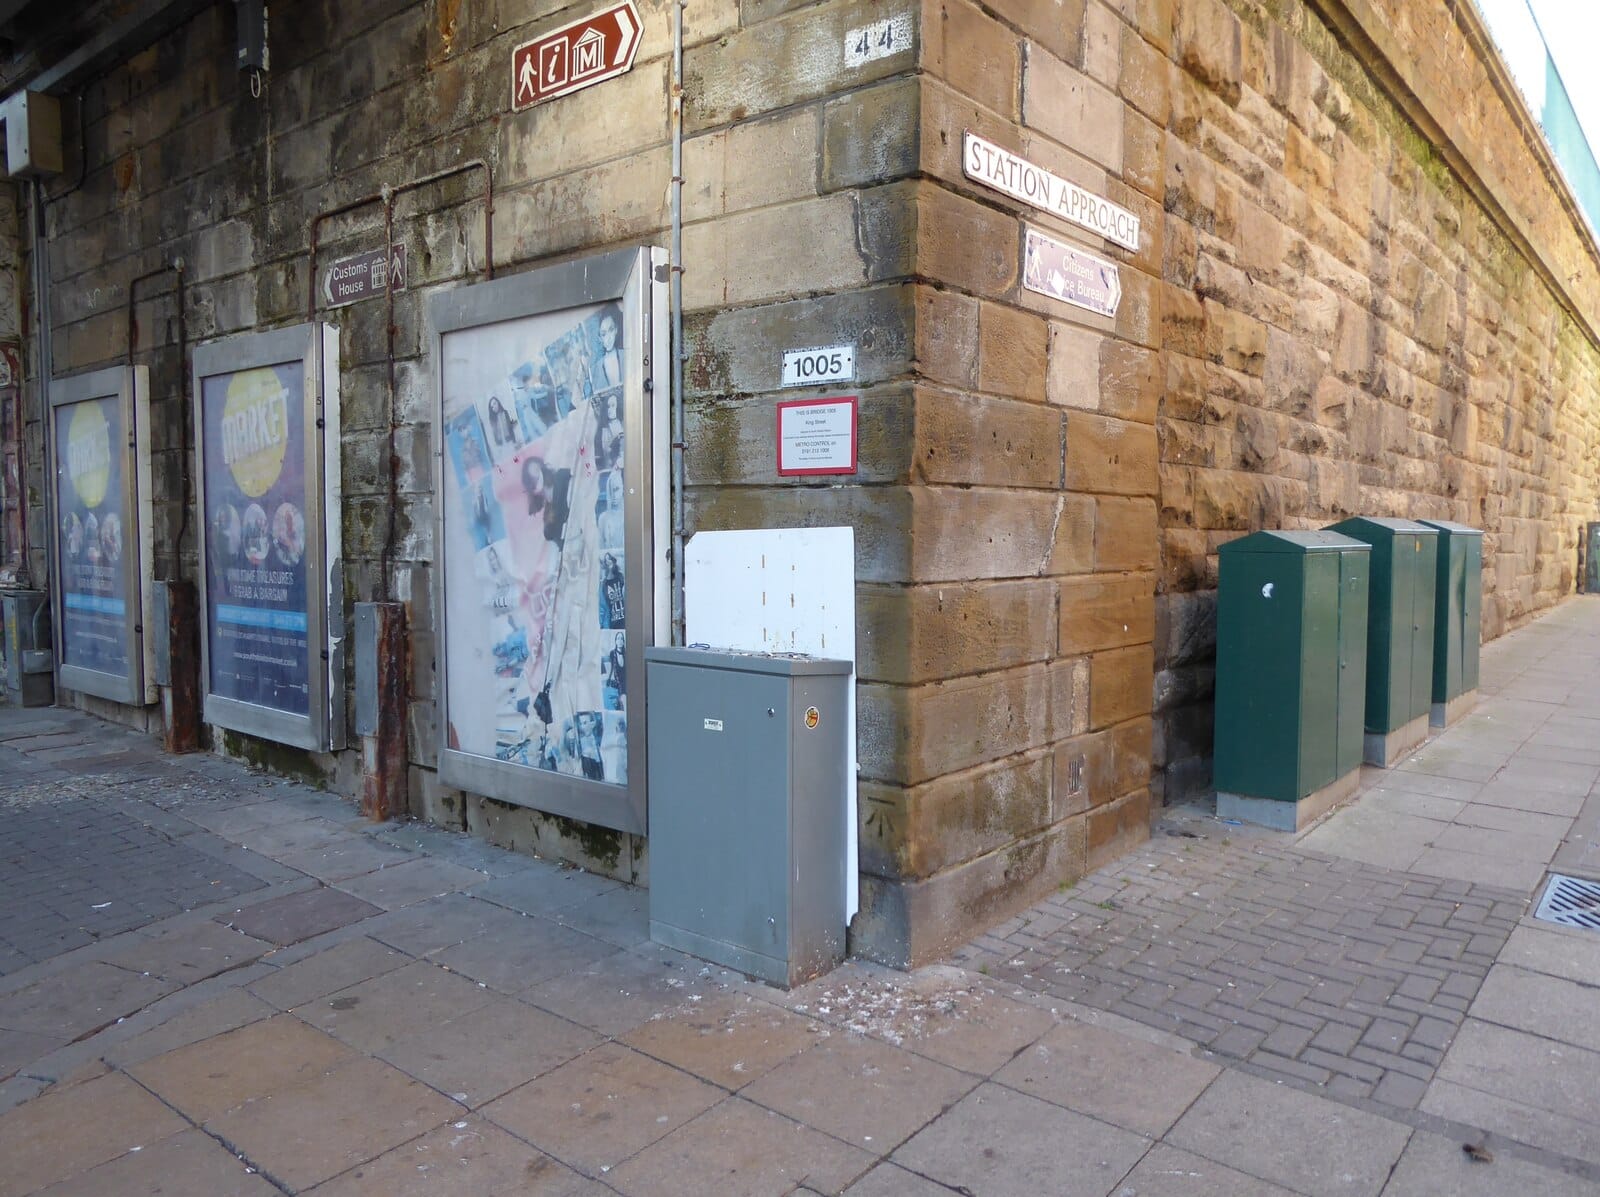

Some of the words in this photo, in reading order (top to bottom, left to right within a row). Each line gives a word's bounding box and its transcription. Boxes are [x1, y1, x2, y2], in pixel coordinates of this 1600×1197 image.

[971, 141, 1050, 204] STATION
[1058, 184, 1136, 246] APPROACH
[333, 262, 368, 281] Customs
[1062, 255, 1094, 281] Citizens
[338, 281, 364, 297] House
[1046, 268, 1075, 292] Ace
[1078, 280, 1105, 302] Bureau
[794, 353, 842, 377] 1005
[222, 387, 289, 465] MARKET
